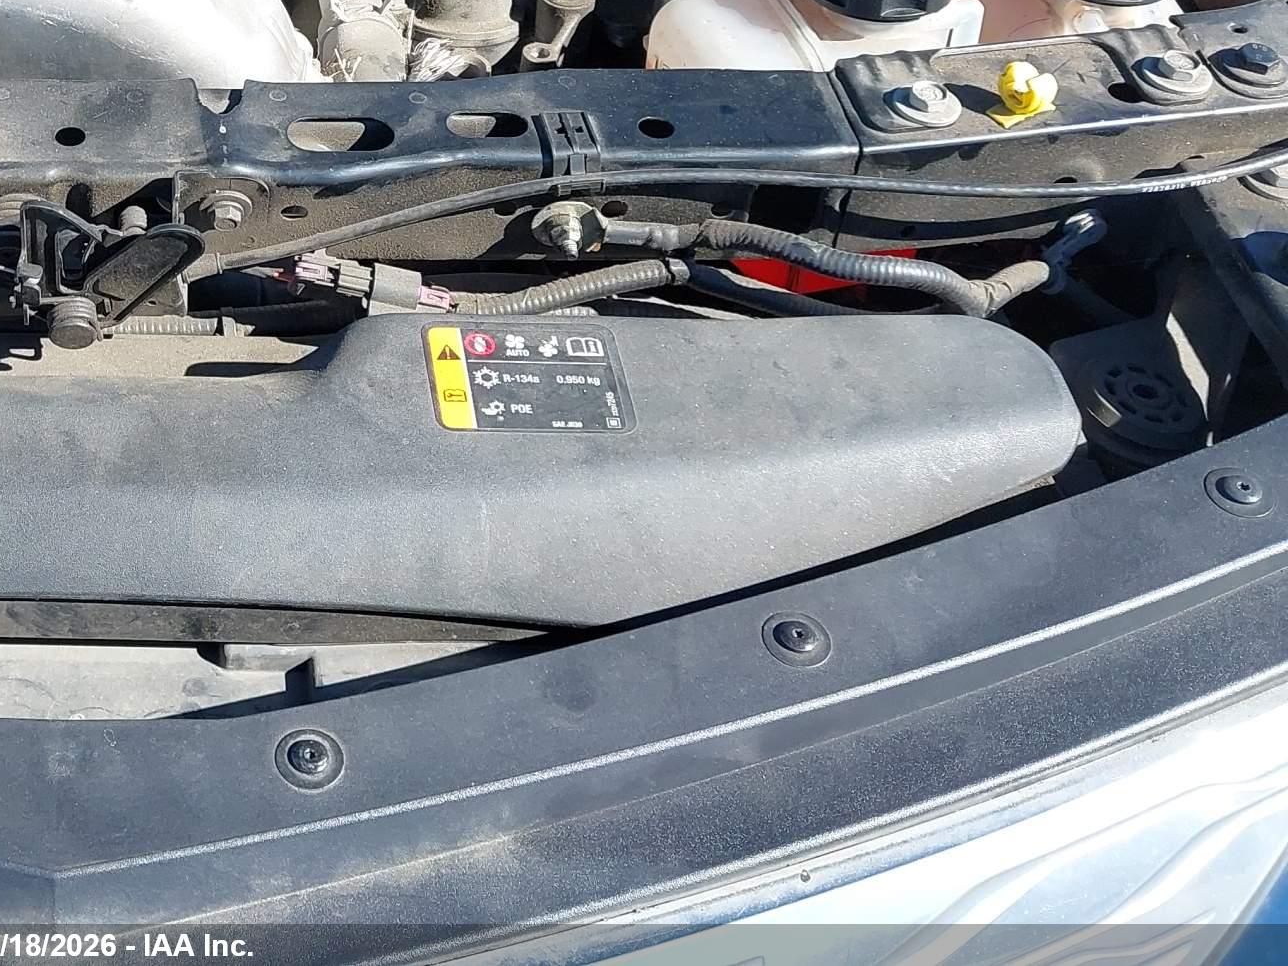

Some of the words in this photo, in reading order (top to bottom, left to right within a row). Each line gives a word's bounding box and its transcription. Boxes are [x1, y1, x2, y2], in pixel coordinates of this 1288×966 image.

[505, 349, 530, 357] AUTO
[502, 373, 540, 384] R-134a
[556, 374, 586, 384] 0.950
[586, 375, 601, 387] kg
[510, 404, 534, 414] POE
